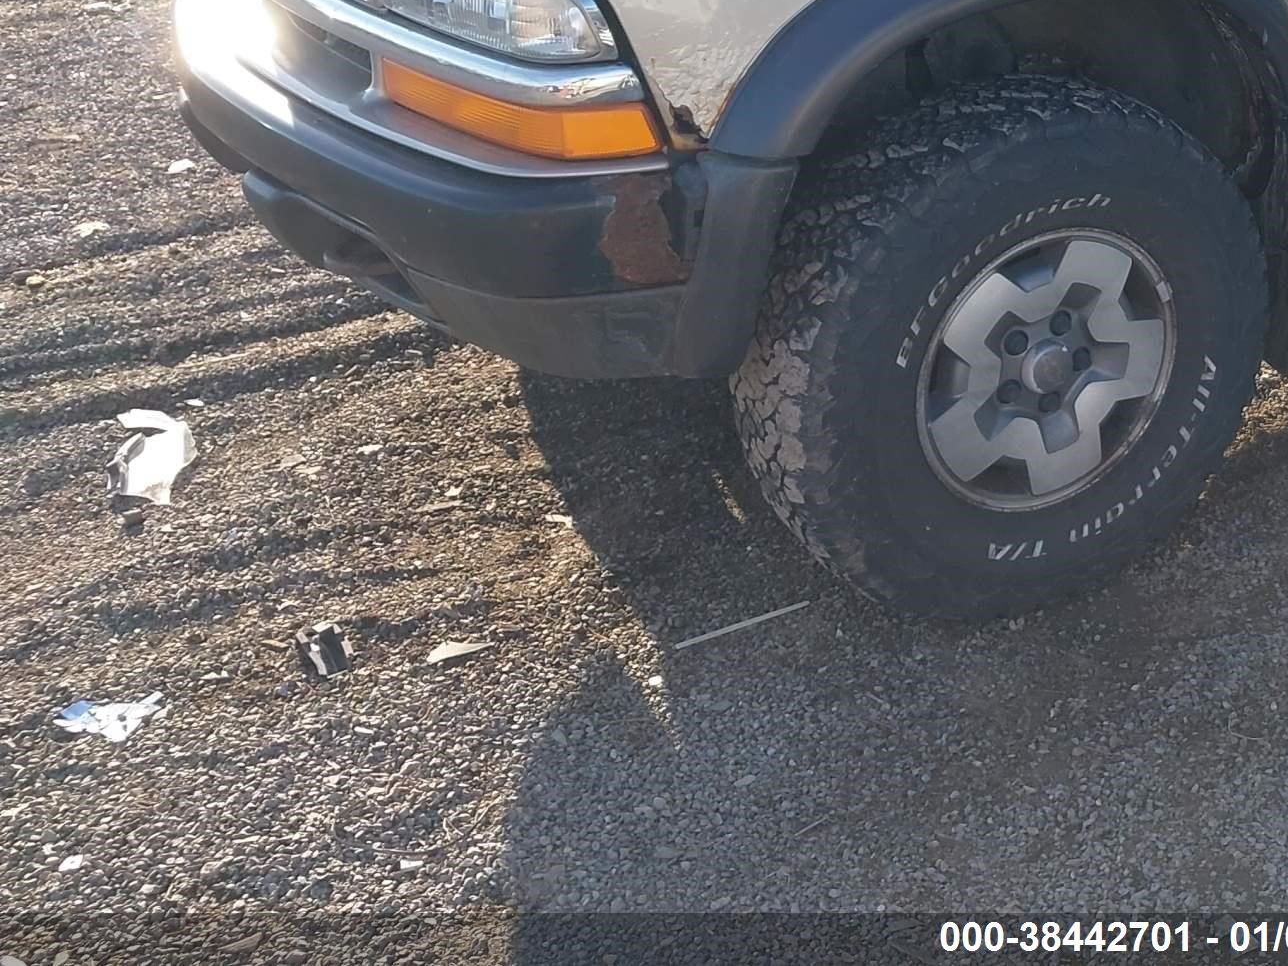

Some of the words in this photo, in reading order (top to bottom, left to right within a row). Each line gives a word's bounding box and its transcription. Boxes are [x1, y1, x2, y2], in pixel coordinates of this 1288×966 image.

[895, 192, 1113, 369] BFGoodrich
[1068, 354, 1218, 542] All-Terrain
[986, 539, 1048, 562] T/A
